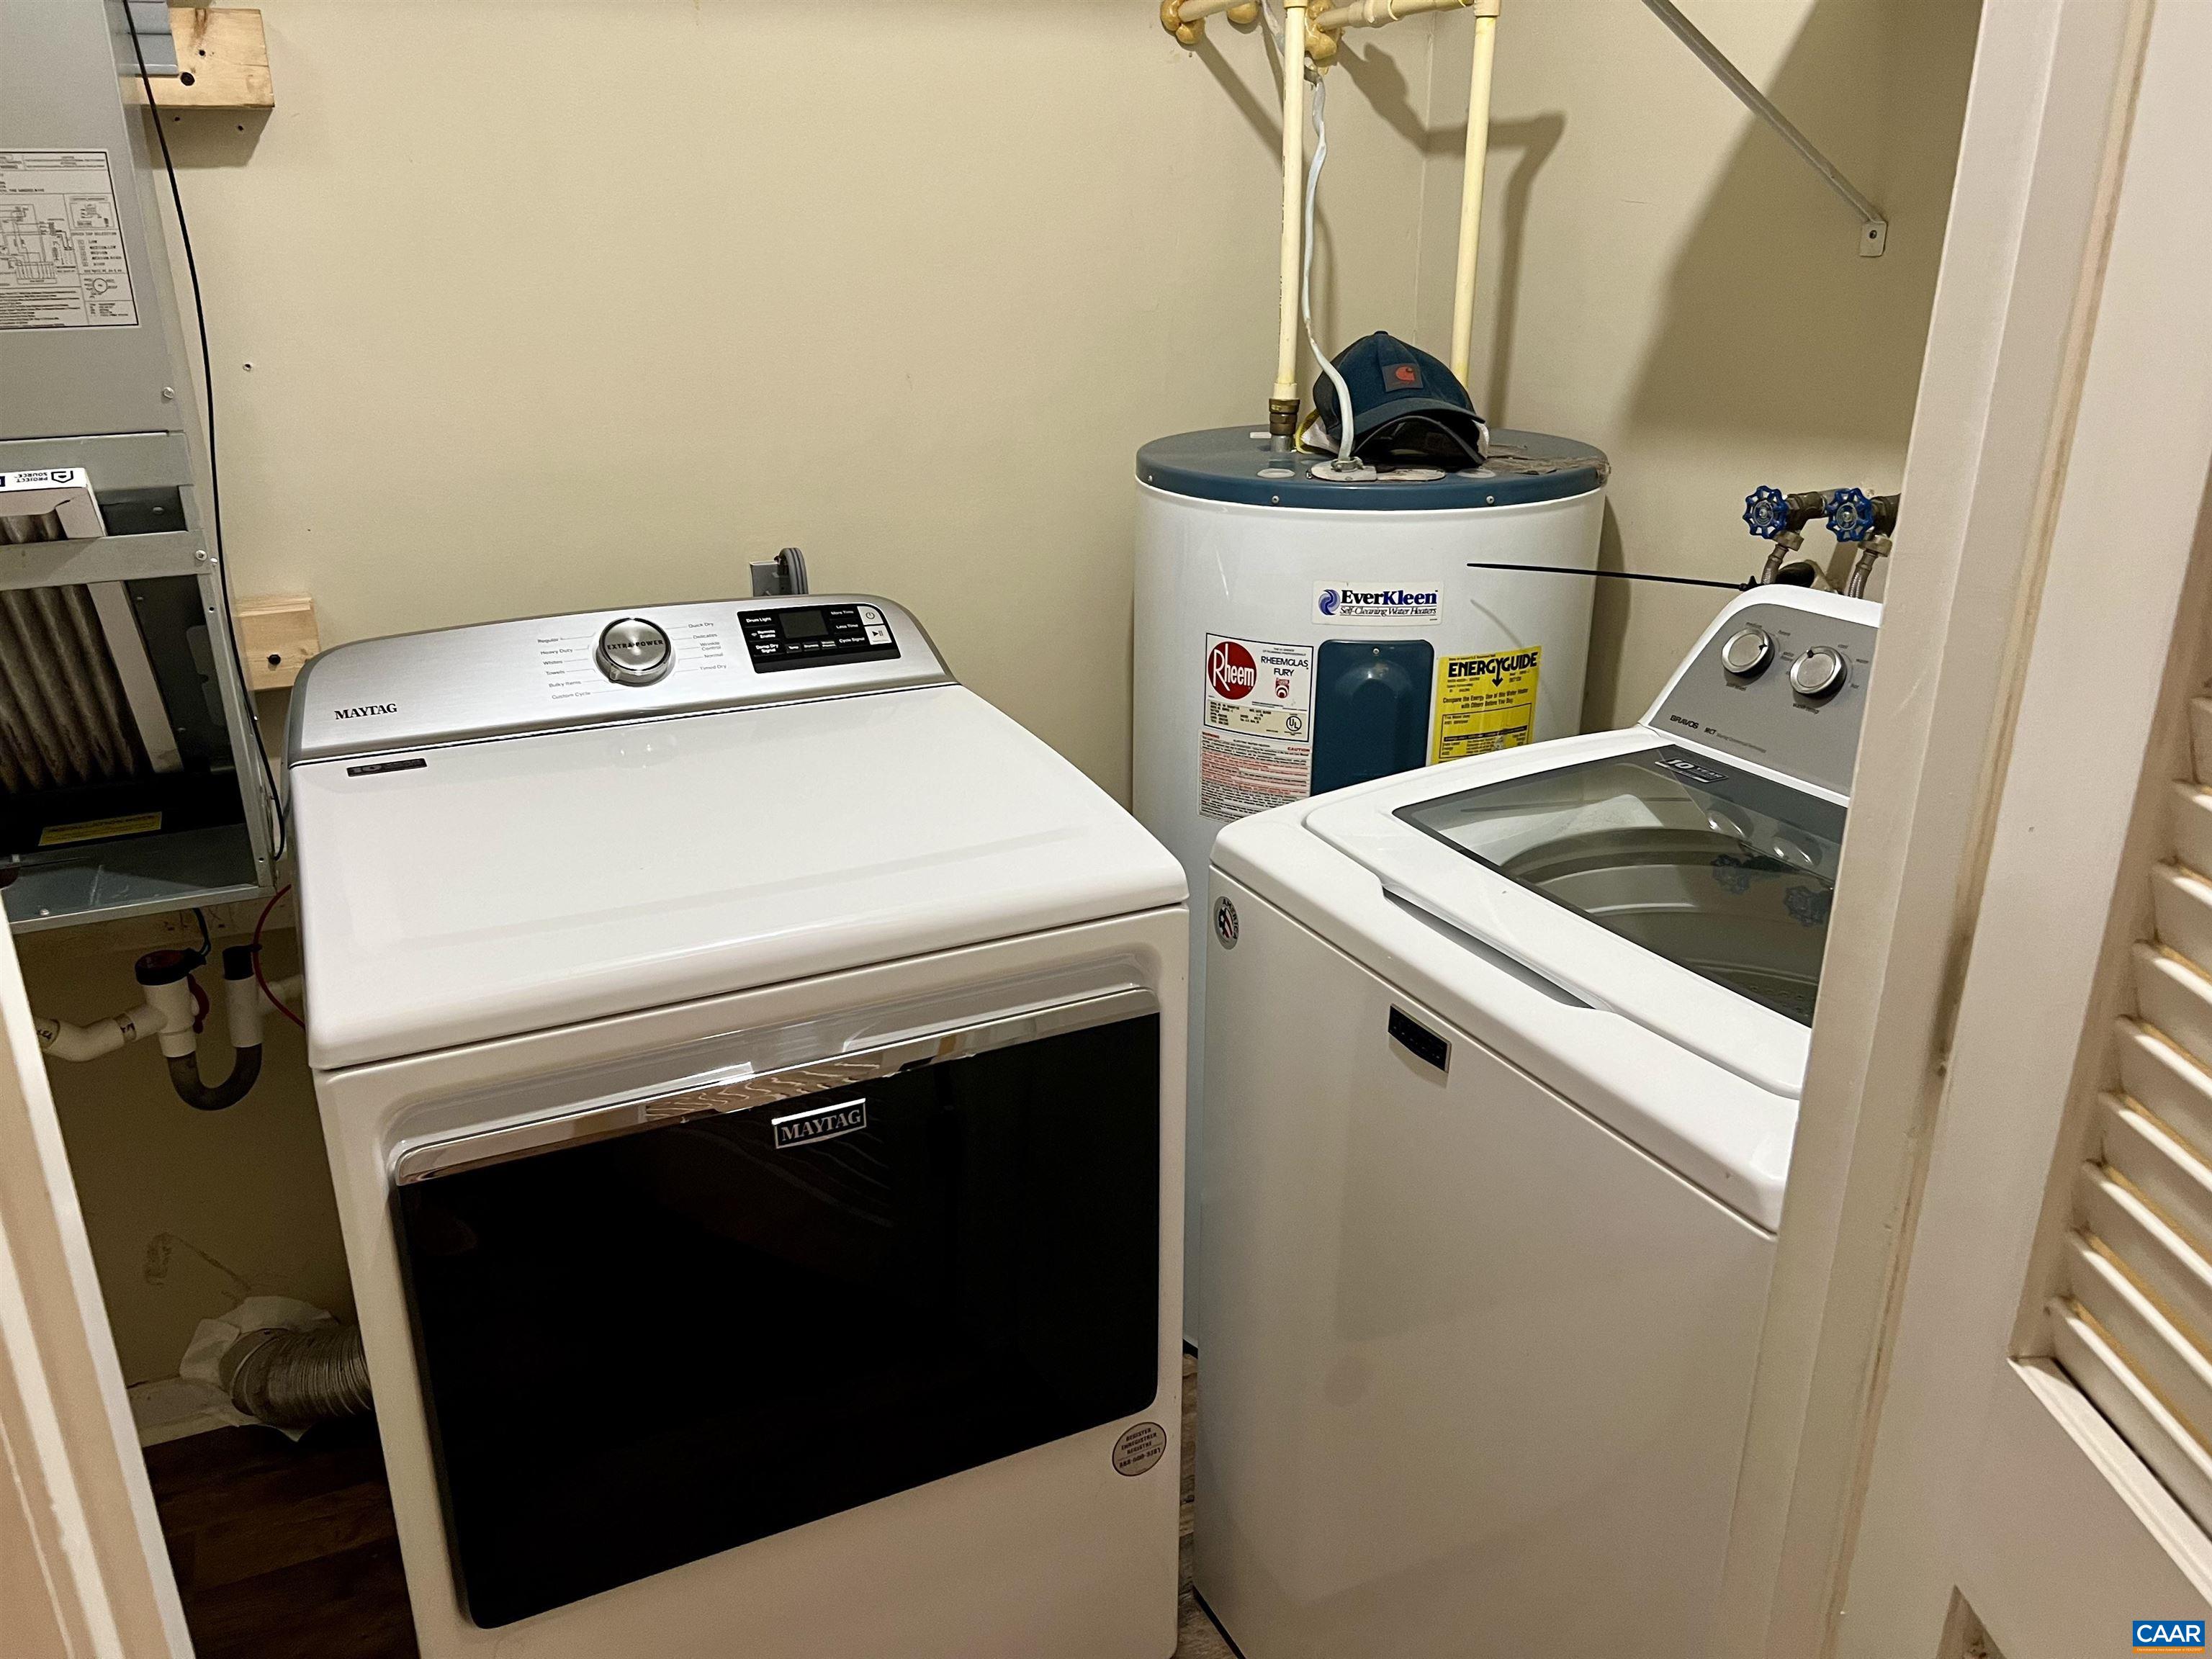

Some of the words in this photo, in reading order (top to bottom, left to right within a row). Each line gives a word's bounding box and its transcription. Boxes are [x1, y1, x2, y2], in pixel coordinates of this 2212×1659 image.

[1340, 589, 1438, 606] EverKleen
[1388, 607, 1410, 616] Water
[1411, 607, 1437, 616] Heaters
[1213, 643, 1254, 692] Rheem
[1260, 655, 1309, 667] RHEEMGLAS
[1448, 652, 1538, 678] ENERGYGUIDE
[1273, 667, 1295, 677] FURY
[333, 703, 397, 720] MAYTAG
[1670, 714, 1699, 729] BRAVOS
[781, 1109, 861, 1141] MAYTAG
